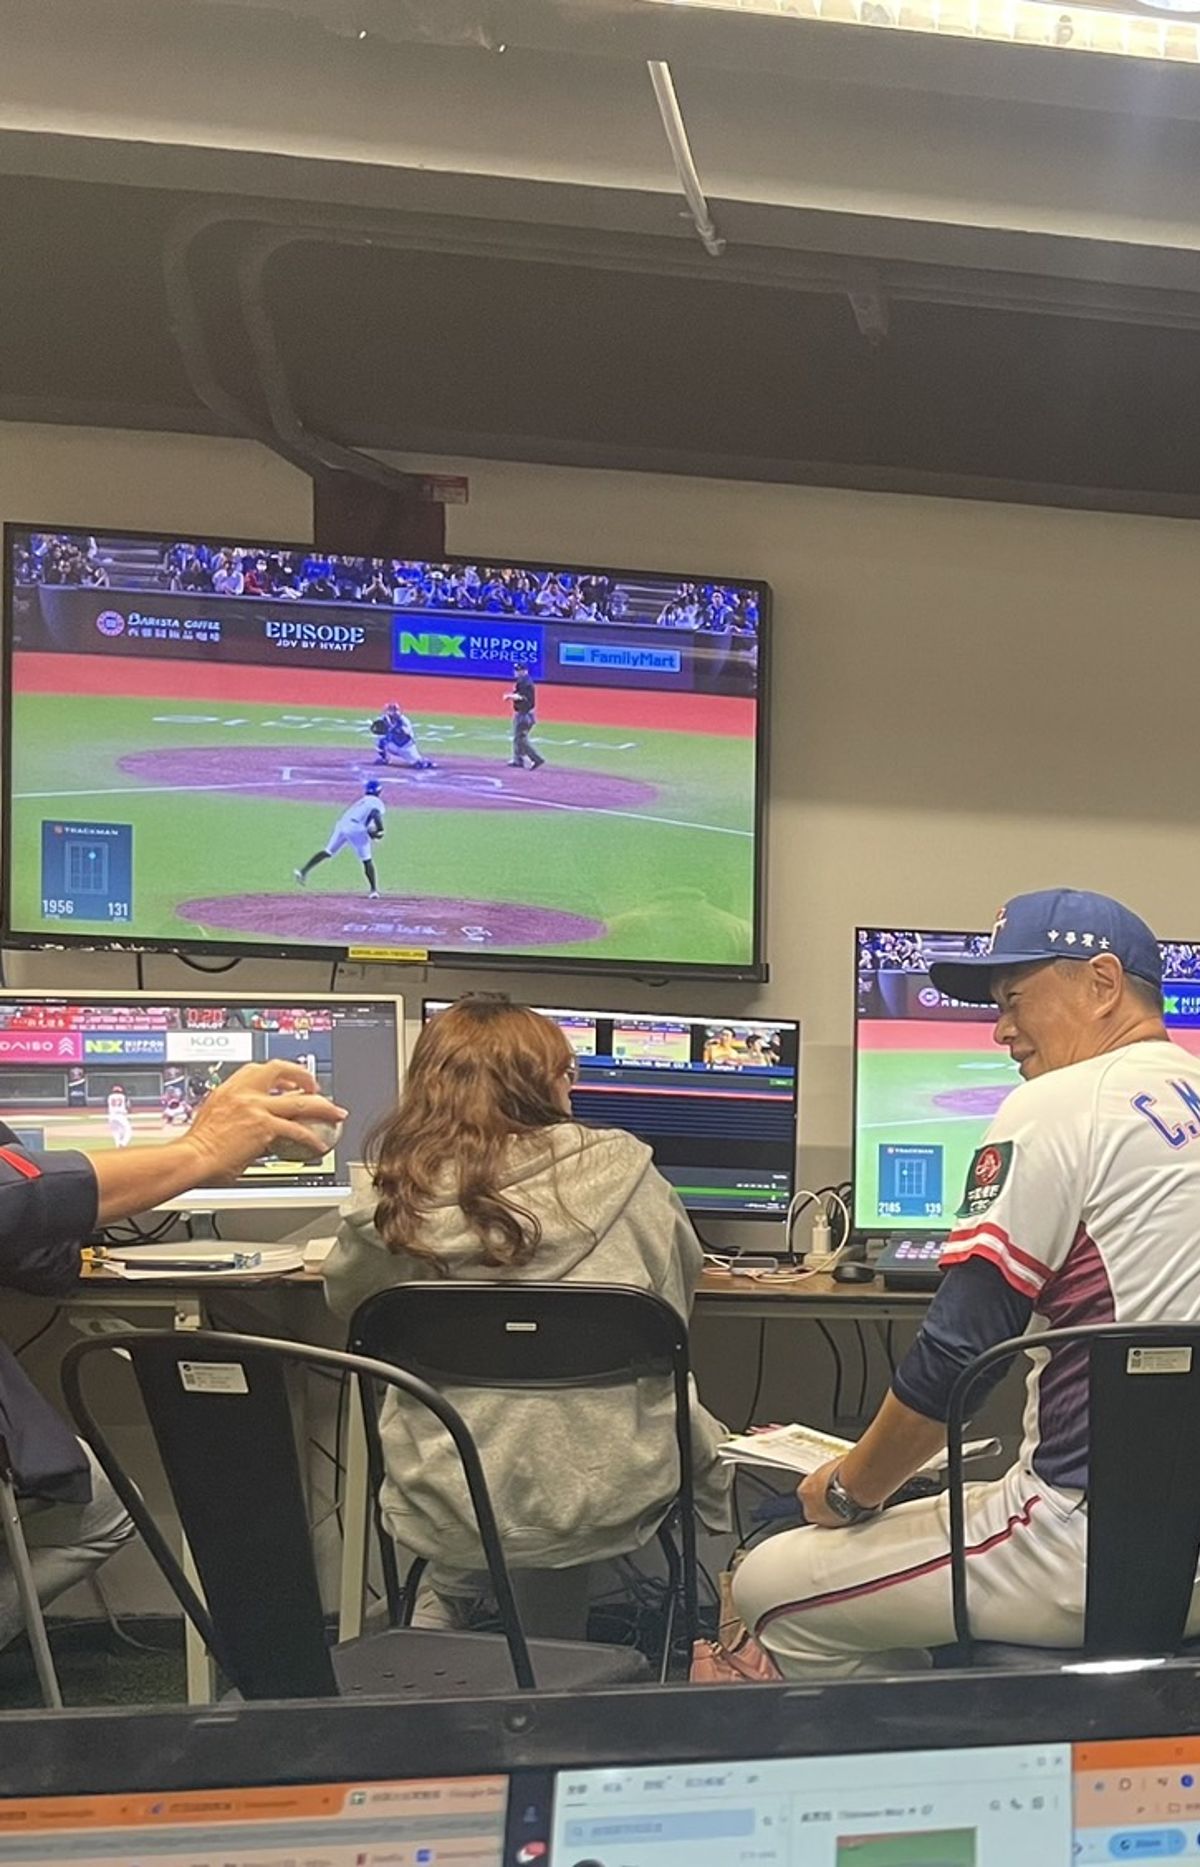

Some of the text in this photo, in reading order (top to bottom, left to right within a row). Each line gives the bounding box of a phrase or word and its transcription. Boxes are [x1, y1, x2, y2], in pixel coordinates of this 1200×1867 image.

[266, 621, 365, 643] EPISODE
[302, 640, 316, 649] BY
[320, 642, 355, 652] HYATT
[469, 636, 537, 651] NIPPON
[469, 648, 538, 663] EXPRESS
[590, 650, 676, 668] FamilyMart
[43, 899, 129, 917] 1956 131
